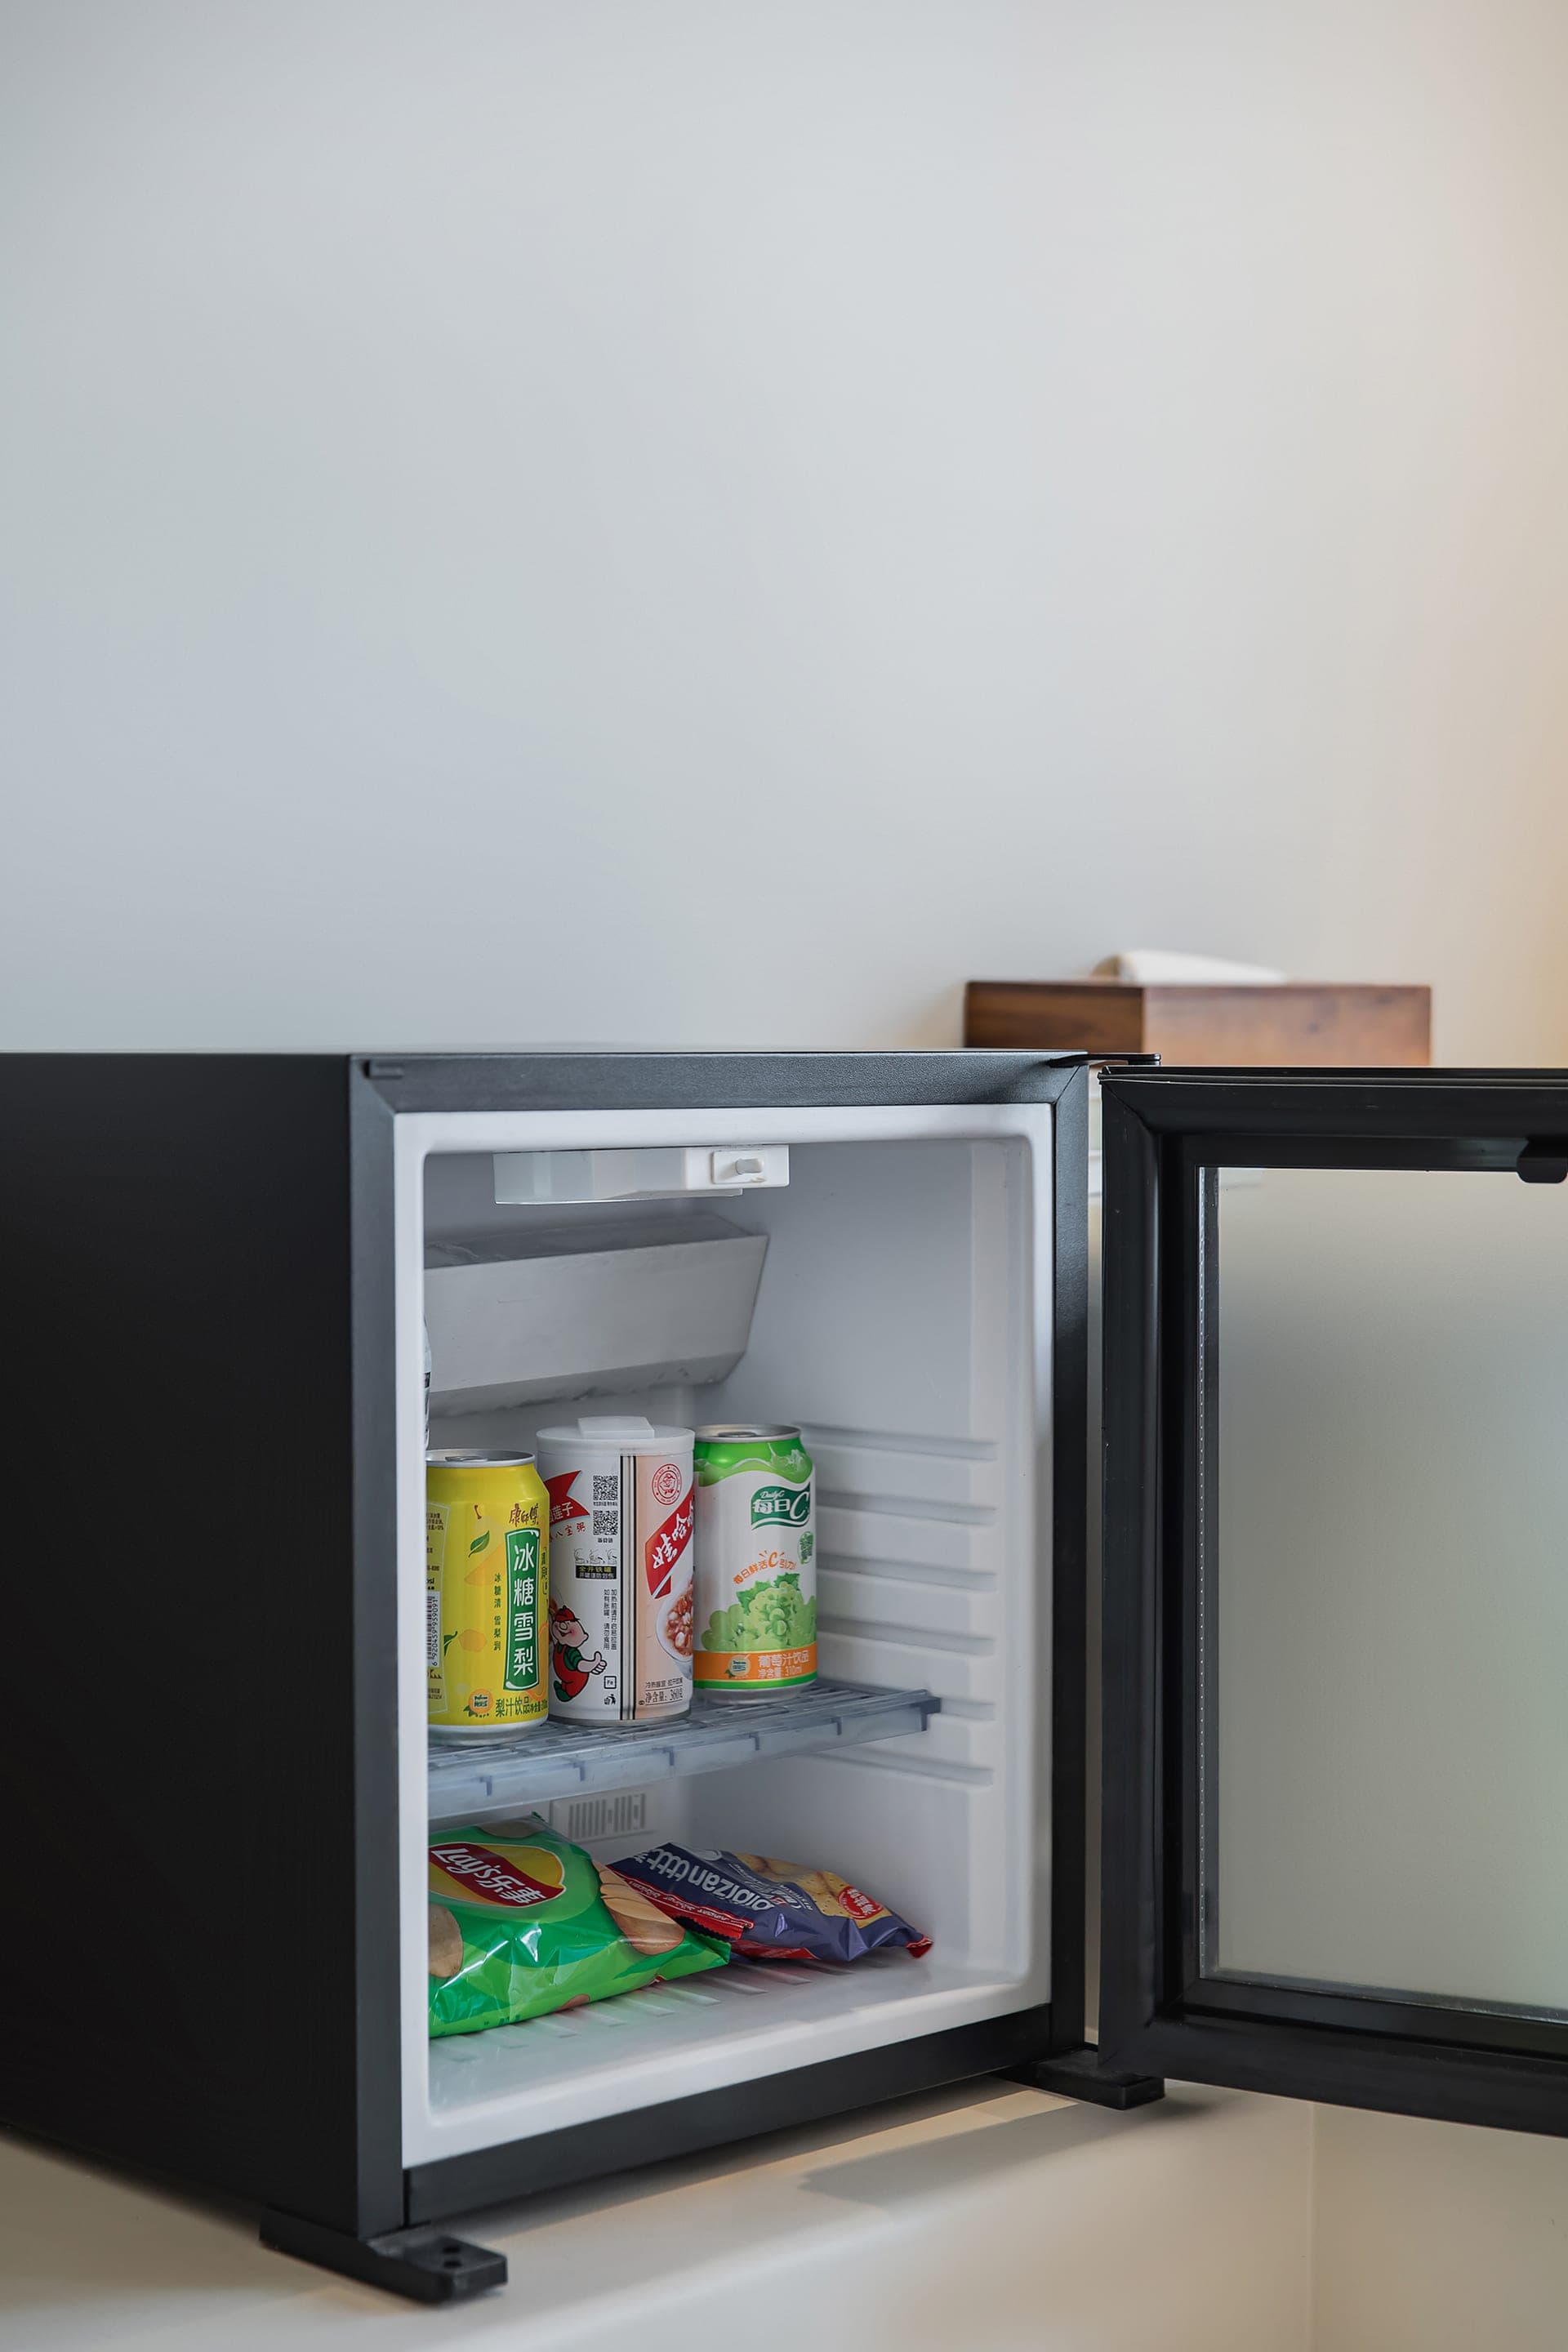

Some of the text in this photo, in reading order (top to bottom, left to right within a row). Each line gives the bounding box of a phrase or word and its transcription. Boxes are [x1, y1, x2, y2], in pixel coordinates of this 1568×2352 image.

[550, 1502, 573, 1522] 莲子
[550, 1521, 586, 1542] 八宝粥
[513, 1543, 535, 1676] 冰糖雪梨
[758, 1650, 808, 1668] 葡萄汁饮品
[431, 1848, 501, 1879] Lay's
[475, 1875, 546, 1904] 乐事
